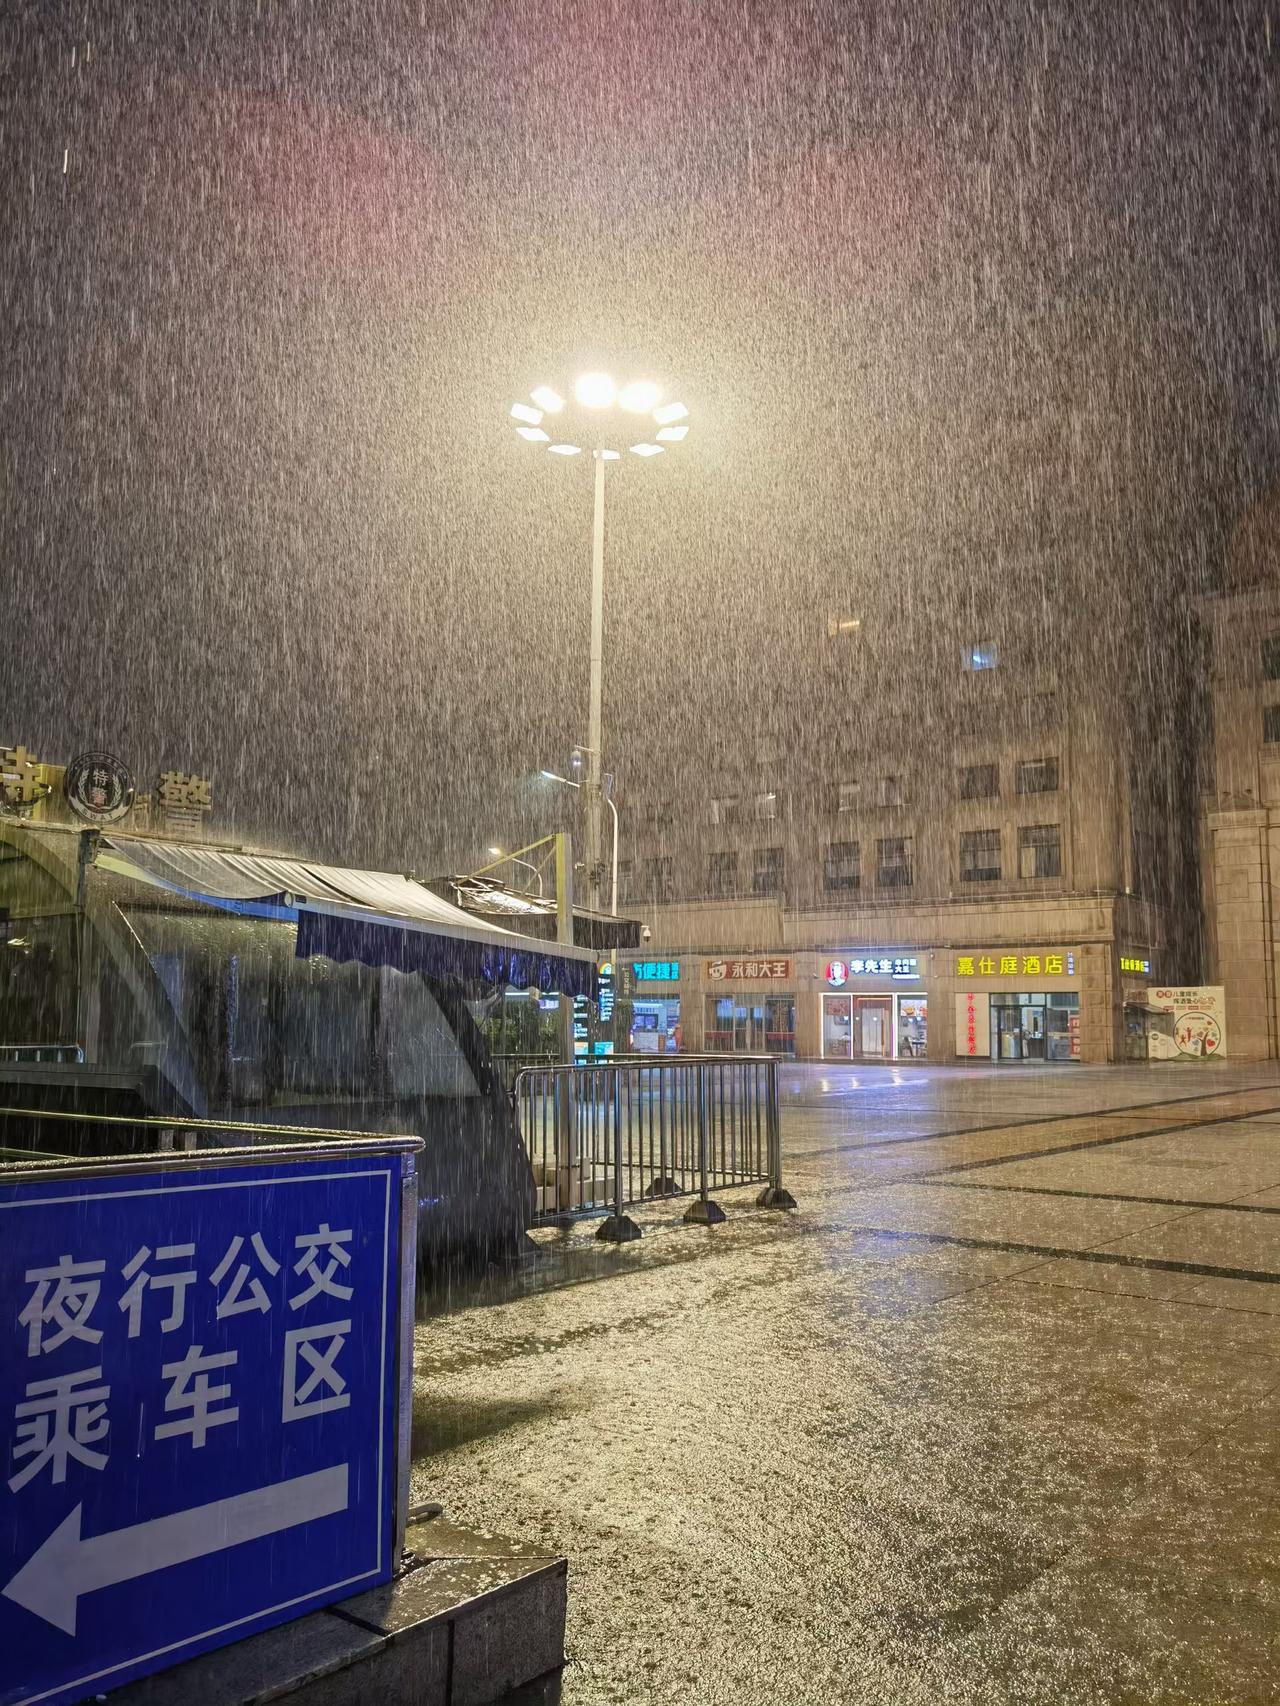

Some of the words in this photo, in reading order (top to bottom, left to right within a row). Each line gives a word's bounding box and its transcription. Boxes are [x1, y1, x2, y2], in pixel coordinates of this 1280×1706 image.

[732, 961, 786, 978] 永和大王
[850, 958, 894, 974] 李先生
[957, 955, 1063, 976] 嘉仕庭酒店
[16, 1222, 355, 1358] 夜行公交
[7, 1319, 352, 1494] 乘车区
